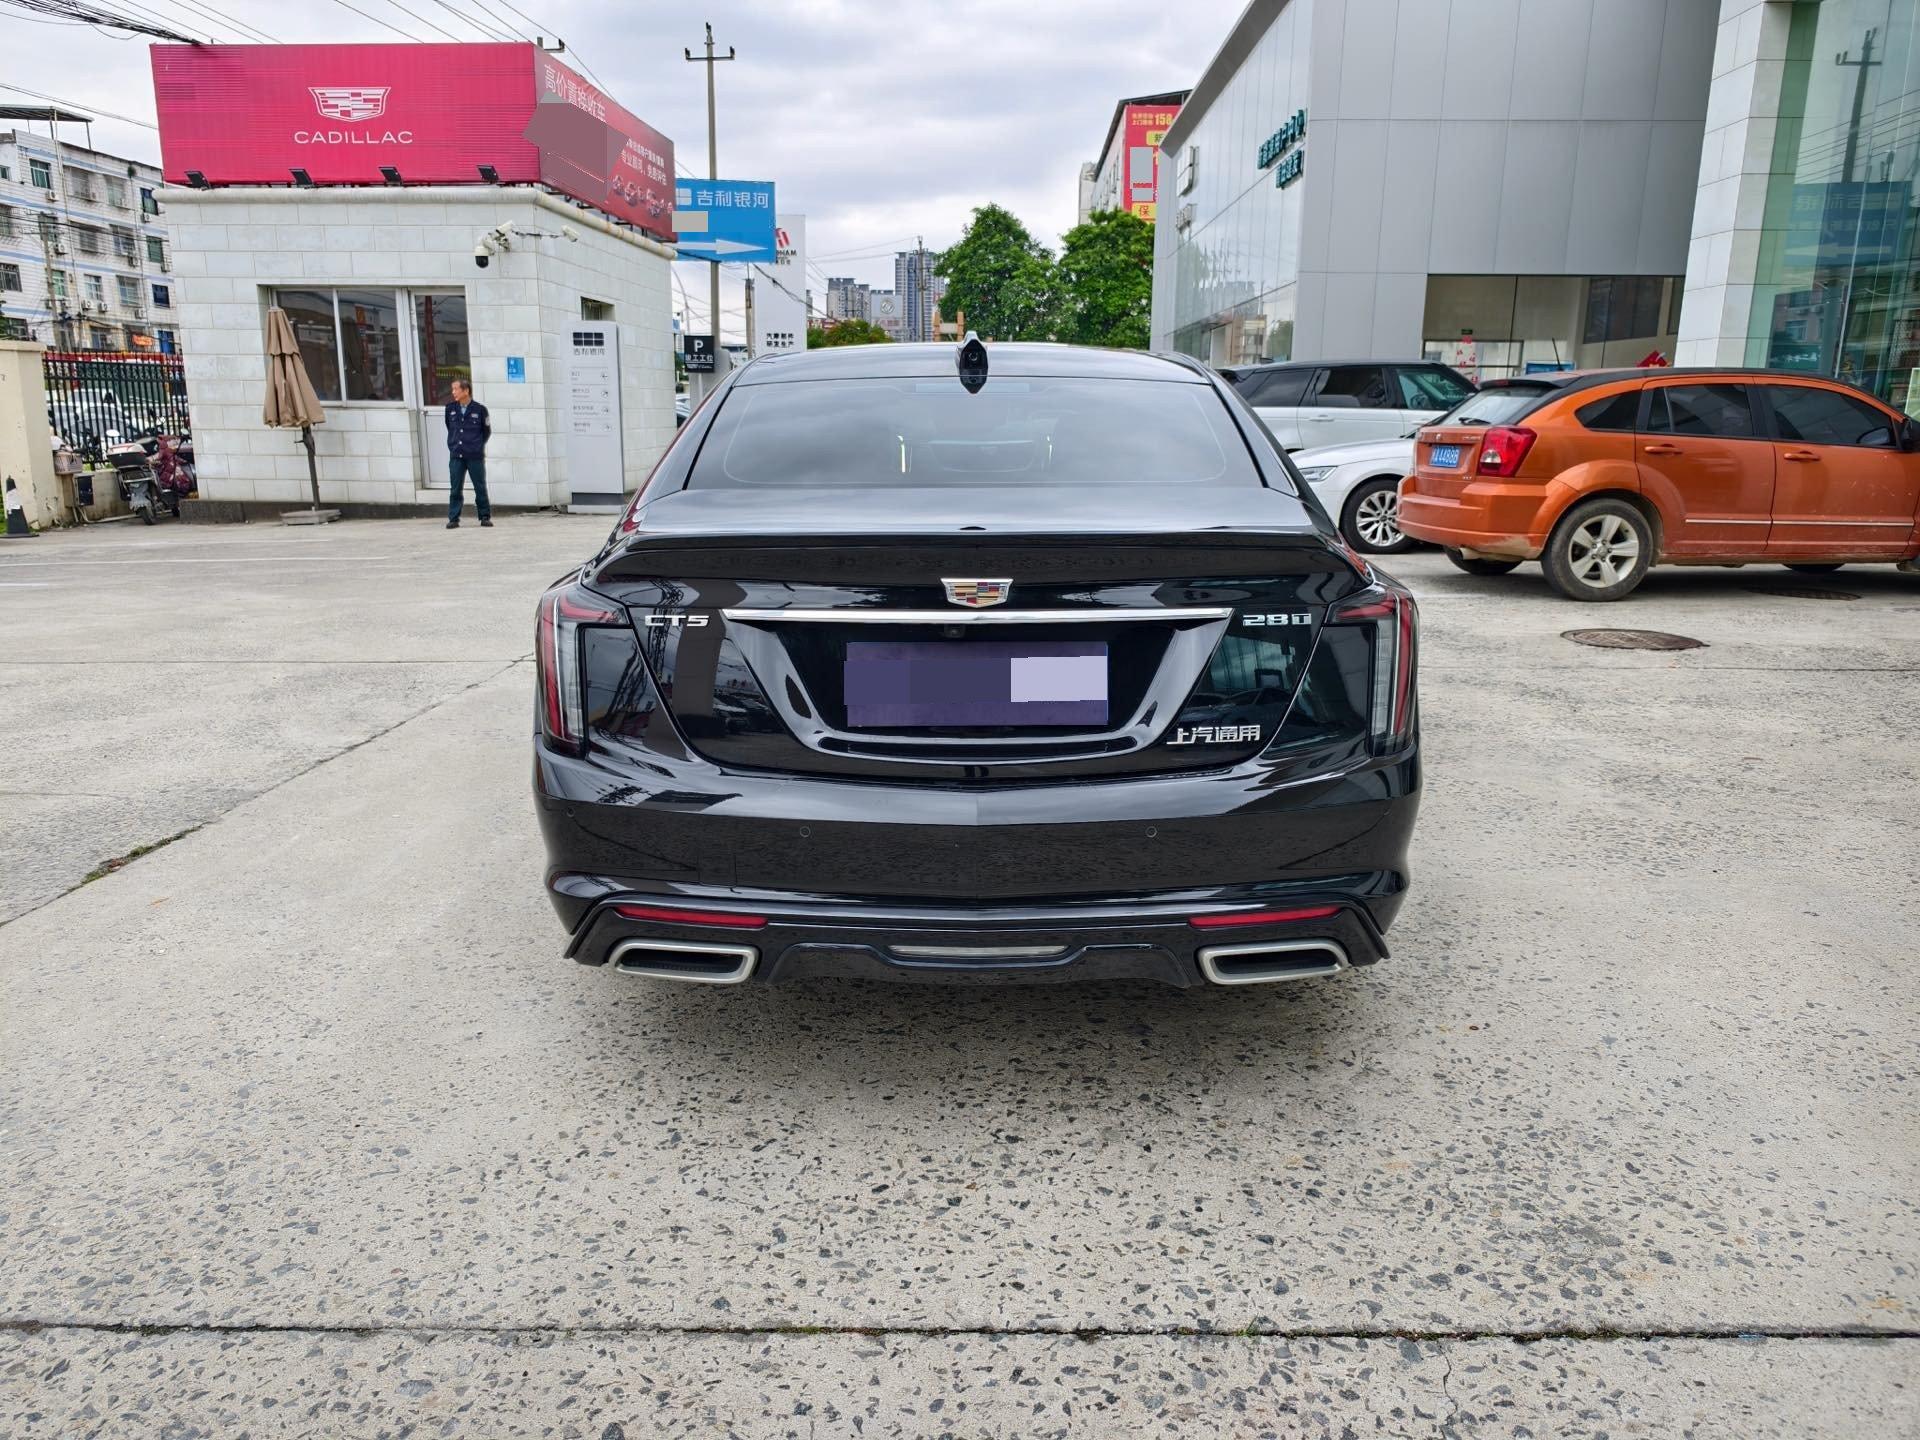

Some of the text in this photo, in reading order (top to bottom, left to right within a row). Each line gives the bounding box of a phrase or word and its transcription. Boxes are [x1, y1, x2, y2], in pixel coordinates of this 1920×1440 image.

[294, 130, 413, 144] CADILLAC
[696, 190, 769, 209] 吉利银河
[694, 339, 704, 352] P
[645, 614, 710, 627] CT5
[1242, 613, 1312, 627] 28T
[1166, 724, 1261, 745] 上汽通用
